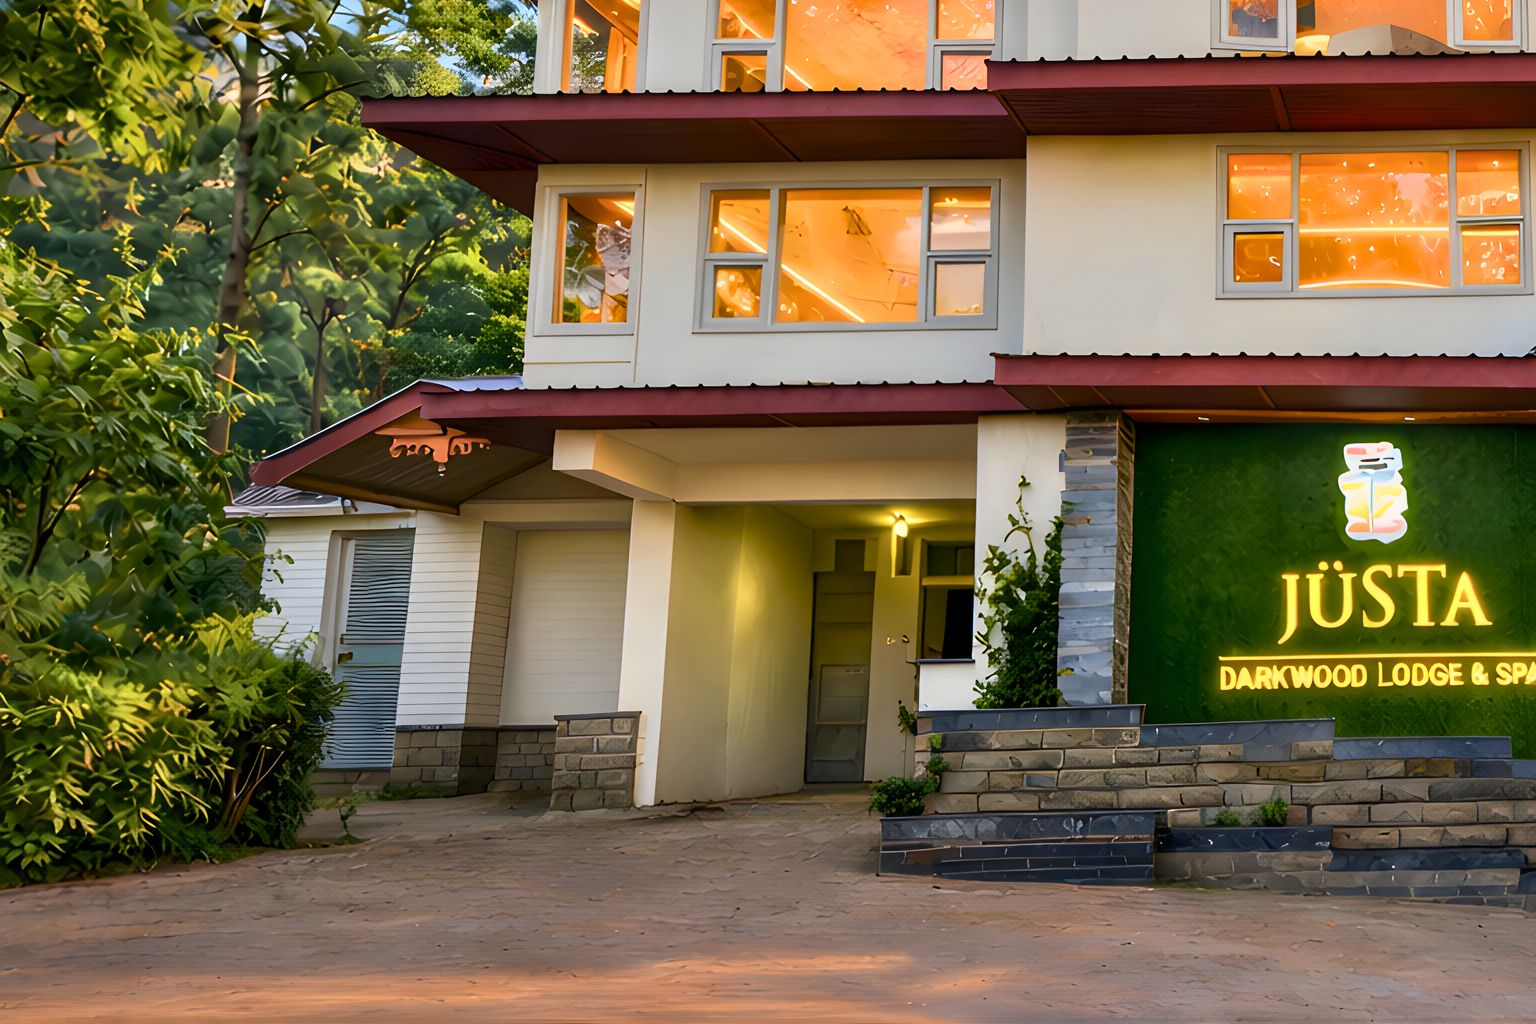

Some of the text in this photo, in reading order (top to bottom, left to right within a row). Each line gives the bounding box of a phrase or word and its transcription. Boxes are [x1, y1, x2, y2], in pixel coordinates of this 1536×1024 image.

[1277, 560, 1494, 645] JÜSTA
[1219, 663, 1368, 691] DARKWOOD
[1377, 661, 1465, 687] LODGE
[1470, 661, 1491, 687] &
